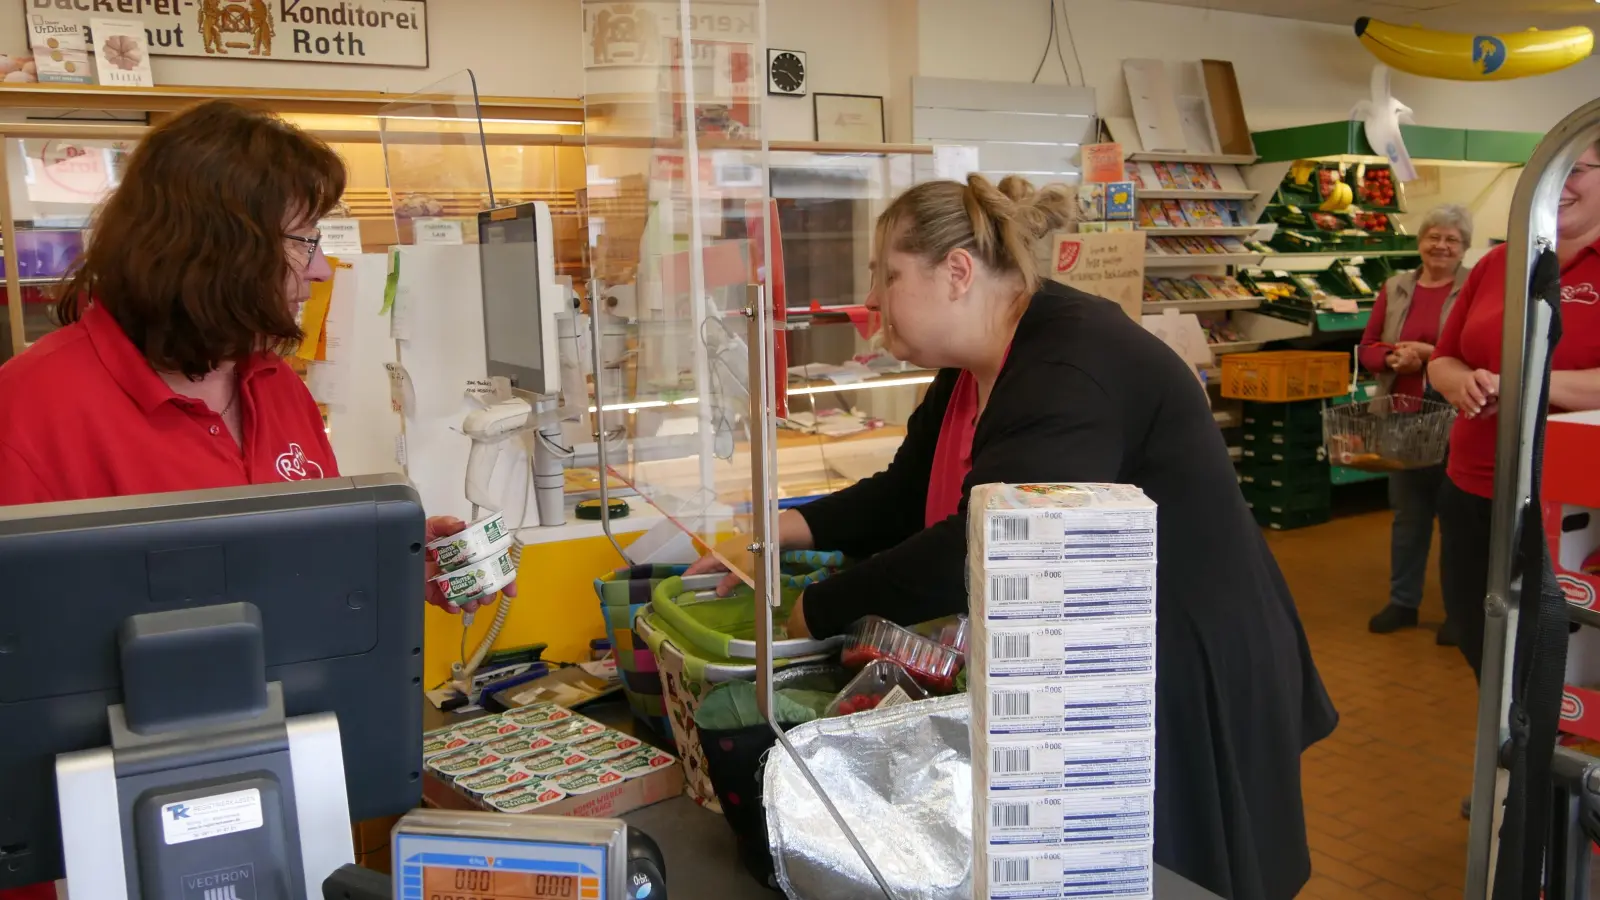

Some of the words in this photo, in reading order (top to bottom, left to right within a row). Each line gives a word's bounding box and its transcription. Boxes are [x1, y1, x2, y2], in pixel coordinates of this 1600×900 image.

[280, 0, 418, 30] Konditorei
[34, 25, 78, 34] UrDinkel
[293, 28, 366, 56] Roth
[166, 803, 191, 821] TK
[188, 869, 249, 890] VECTRON
